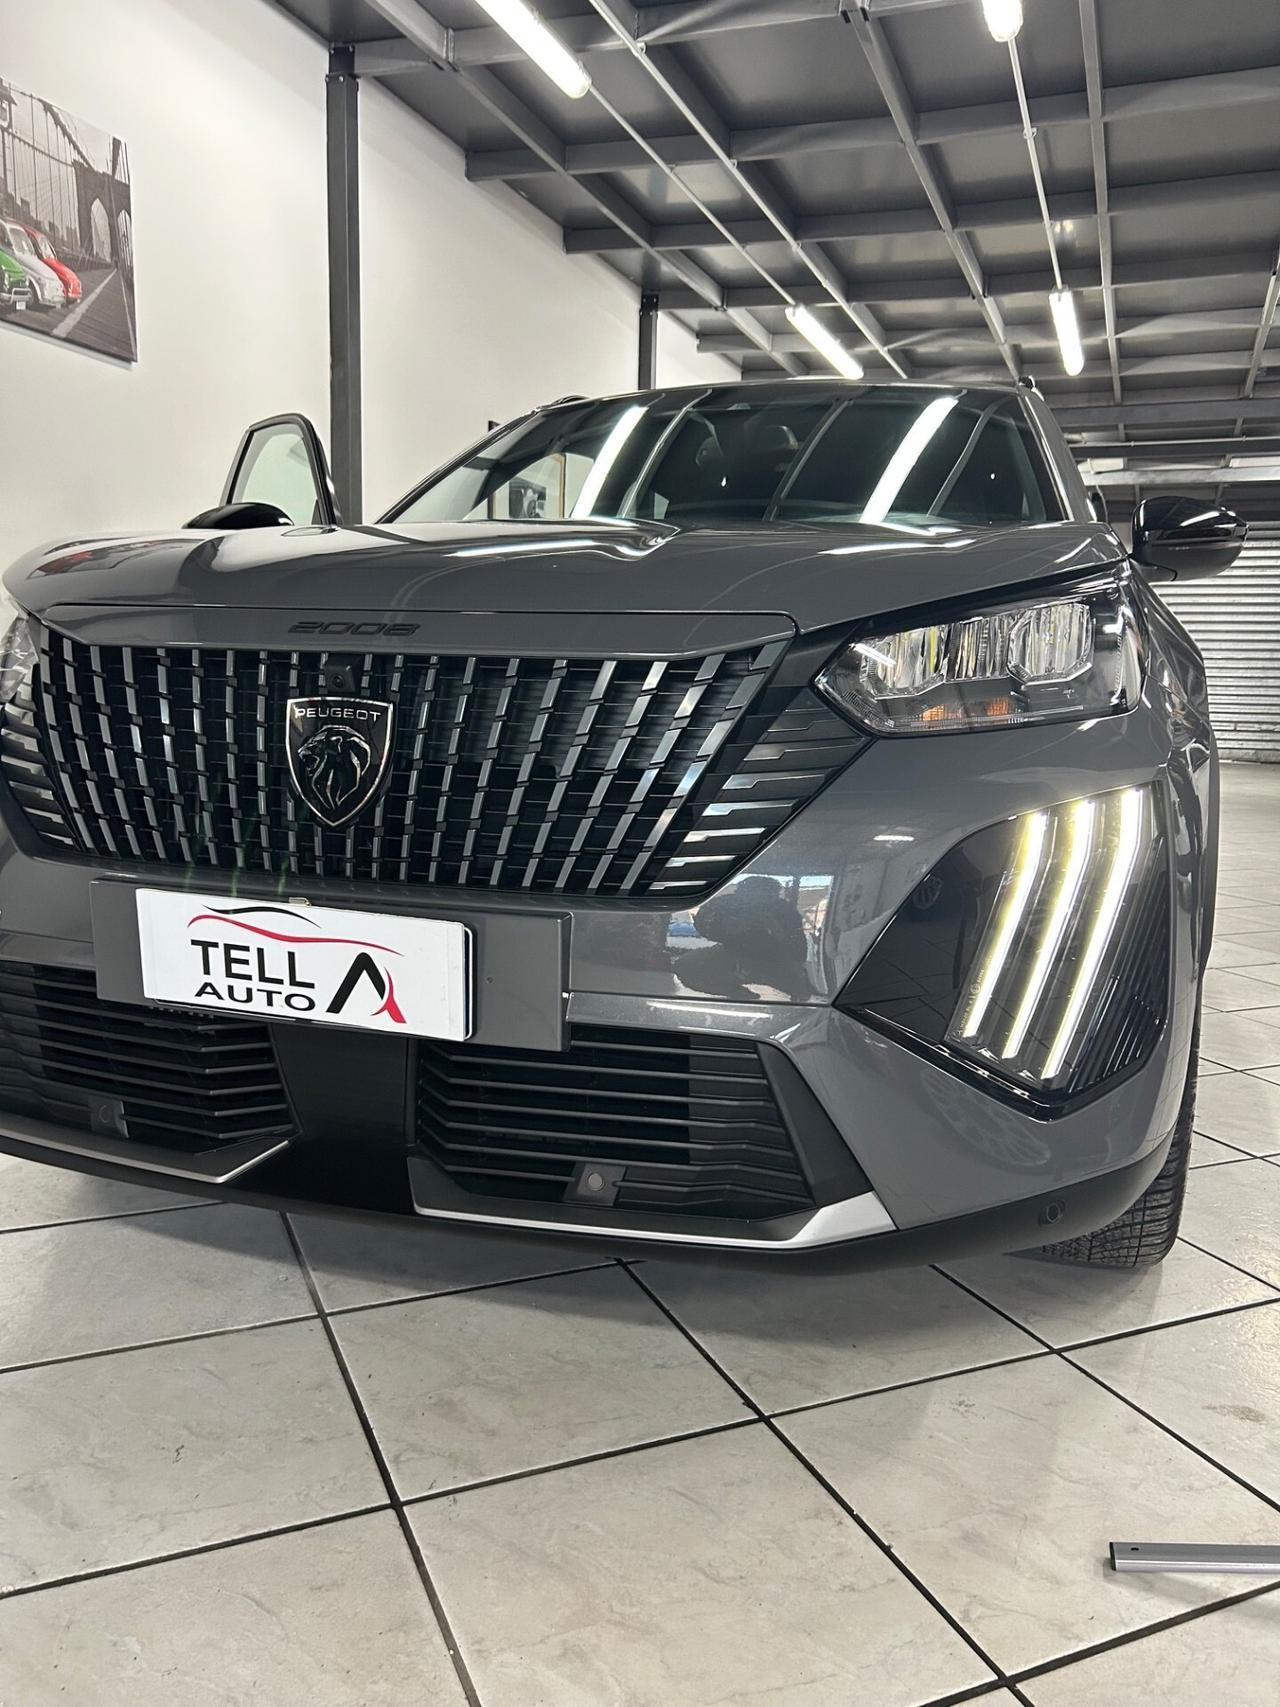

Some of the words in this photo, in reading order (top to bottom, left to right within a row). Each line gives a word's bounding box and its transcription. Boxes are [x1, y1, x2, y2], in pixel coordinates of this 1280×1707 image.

[287, 621, 421, 637] 2008
[294, 707, 382, 722] PEUGEOT
[190, 938, 316, 990] TELL
[194, 981, 316, 1012] AUTO
